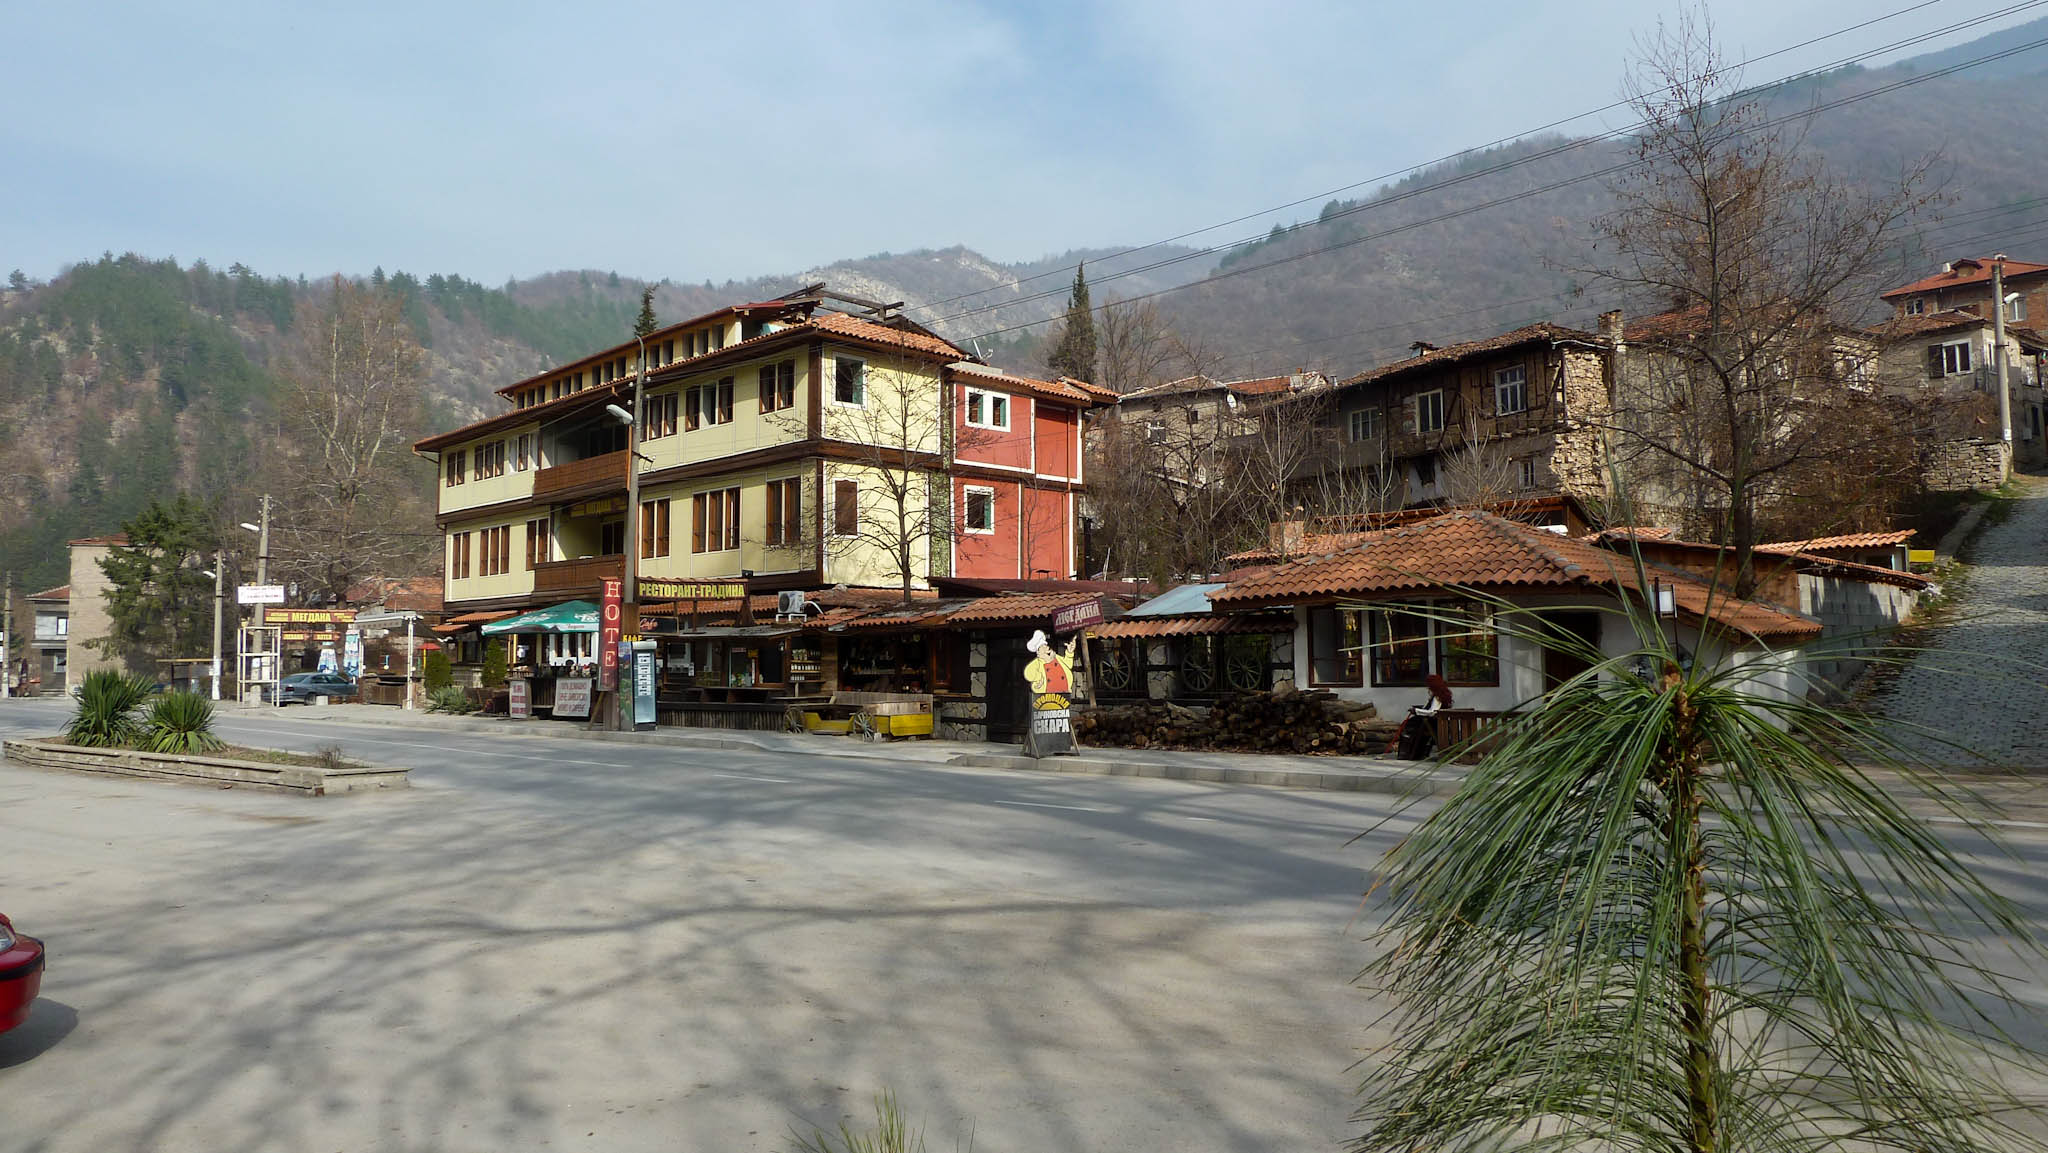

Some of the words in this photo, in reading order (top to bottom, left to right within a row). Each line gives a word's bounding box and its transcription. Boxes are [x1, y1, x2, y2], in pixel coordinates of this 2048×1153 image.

[640, 583, 745, 599] РЕСТОРАНТ-ГРАДИНА
[291, 612, 331, 623] МЕГДАНА
[1033, 719, 1070, 734] СКАРА
